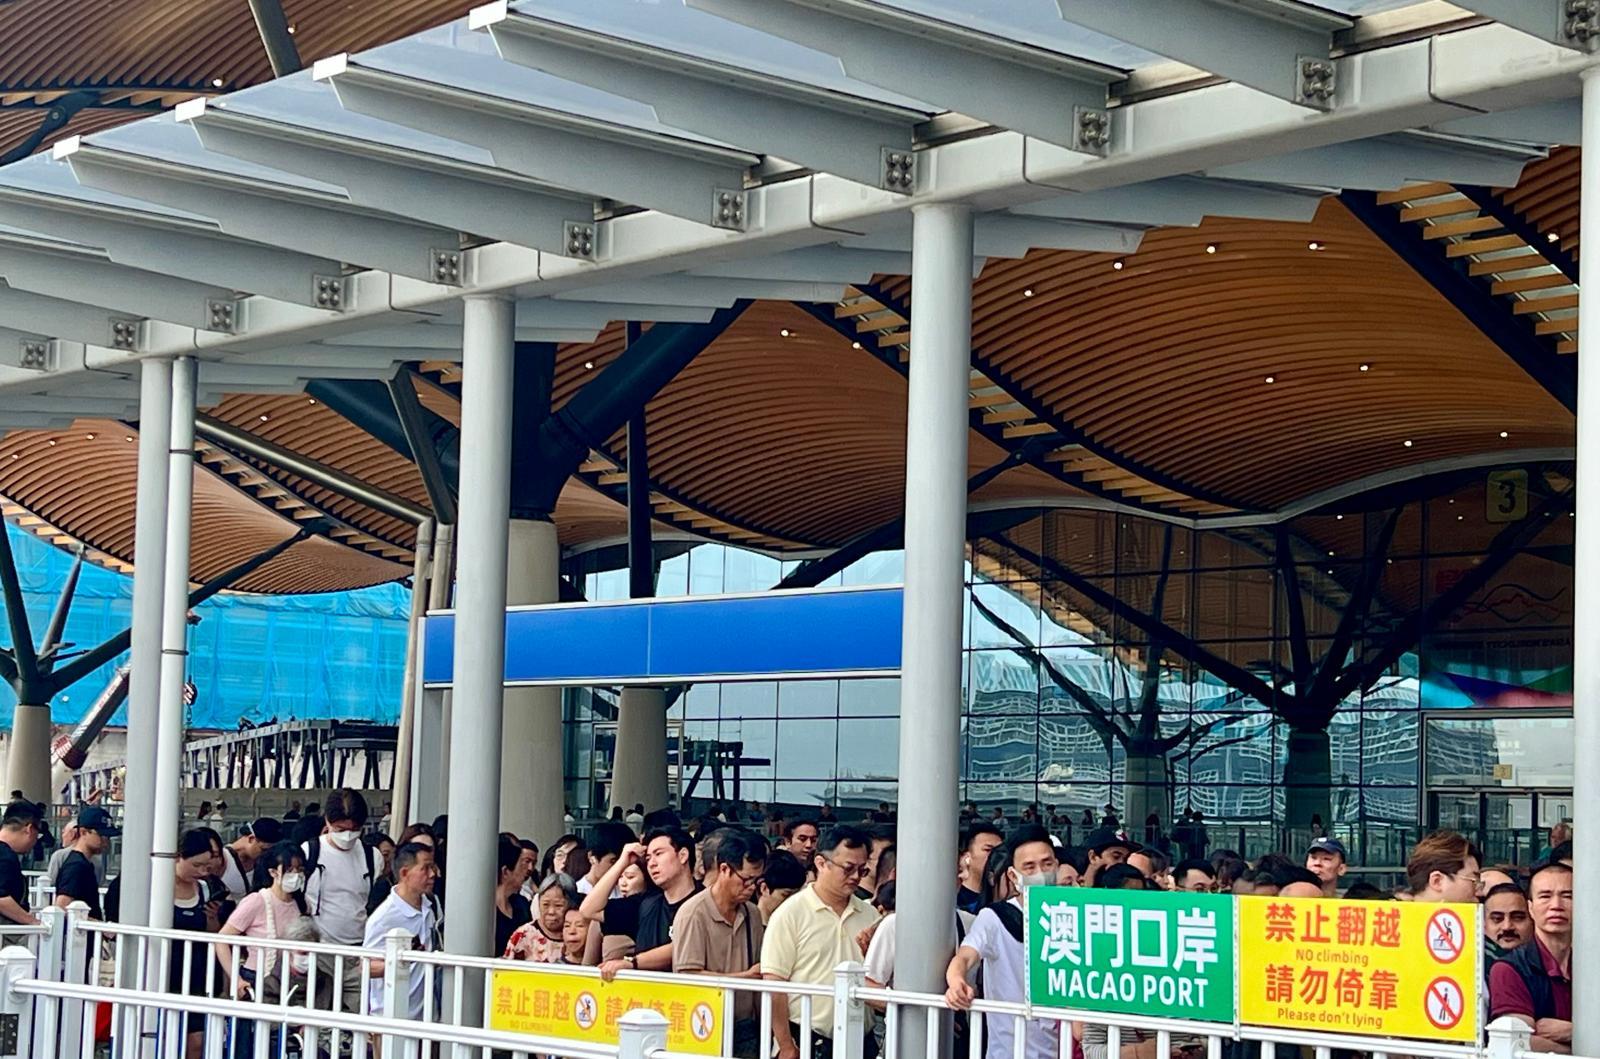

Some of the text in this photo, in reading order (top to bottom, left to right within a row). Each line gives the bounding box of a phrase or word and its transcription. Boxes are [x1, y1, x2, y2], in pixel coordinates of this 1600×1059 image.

[1499, 479, 1516, 514] 3
[1038, 901, 1219, 973] 澳門口岸
[1265, 903, 1401, 948] 禁止翻越
[1296, 949, 1369, 967] NO climbing
[497, 986, 570, 1021] 禁止翻越
[1048, 968, 1209, 1008] MACAO PORT
[1265, 964, 1399, 1010] 請勿倚靠
[1277, 1008, 1383, 1028] Please don't lying
